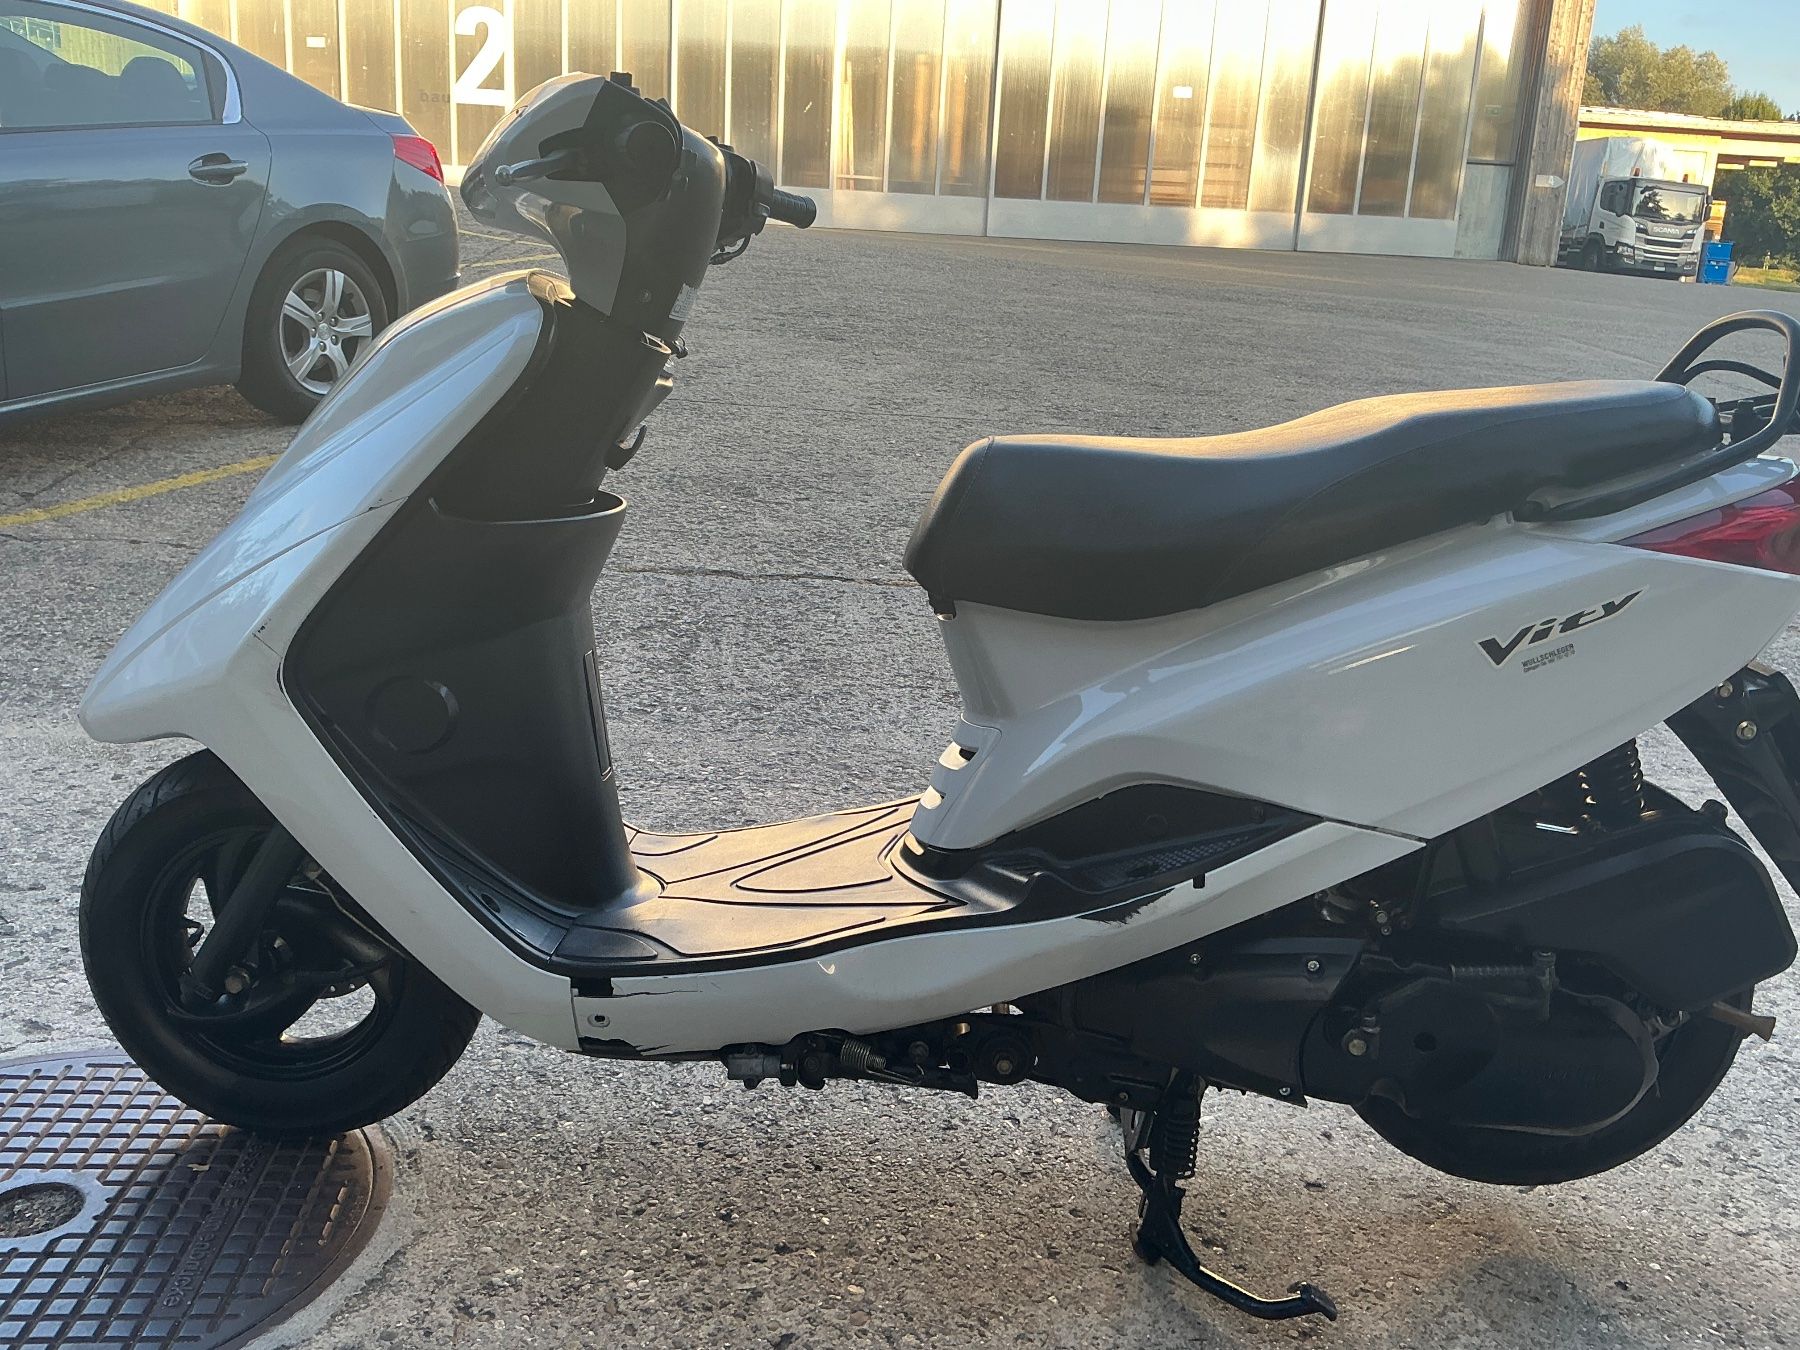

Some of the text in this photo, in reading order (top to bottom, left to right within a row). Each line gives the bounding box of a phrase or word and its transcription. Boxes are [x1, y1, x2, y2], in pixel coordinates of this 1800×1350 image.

[454, 5, 507, 107] 2
[1653, 226, 1680, 235] SCANIA
[1478, 589, 1644, 666] Vity
